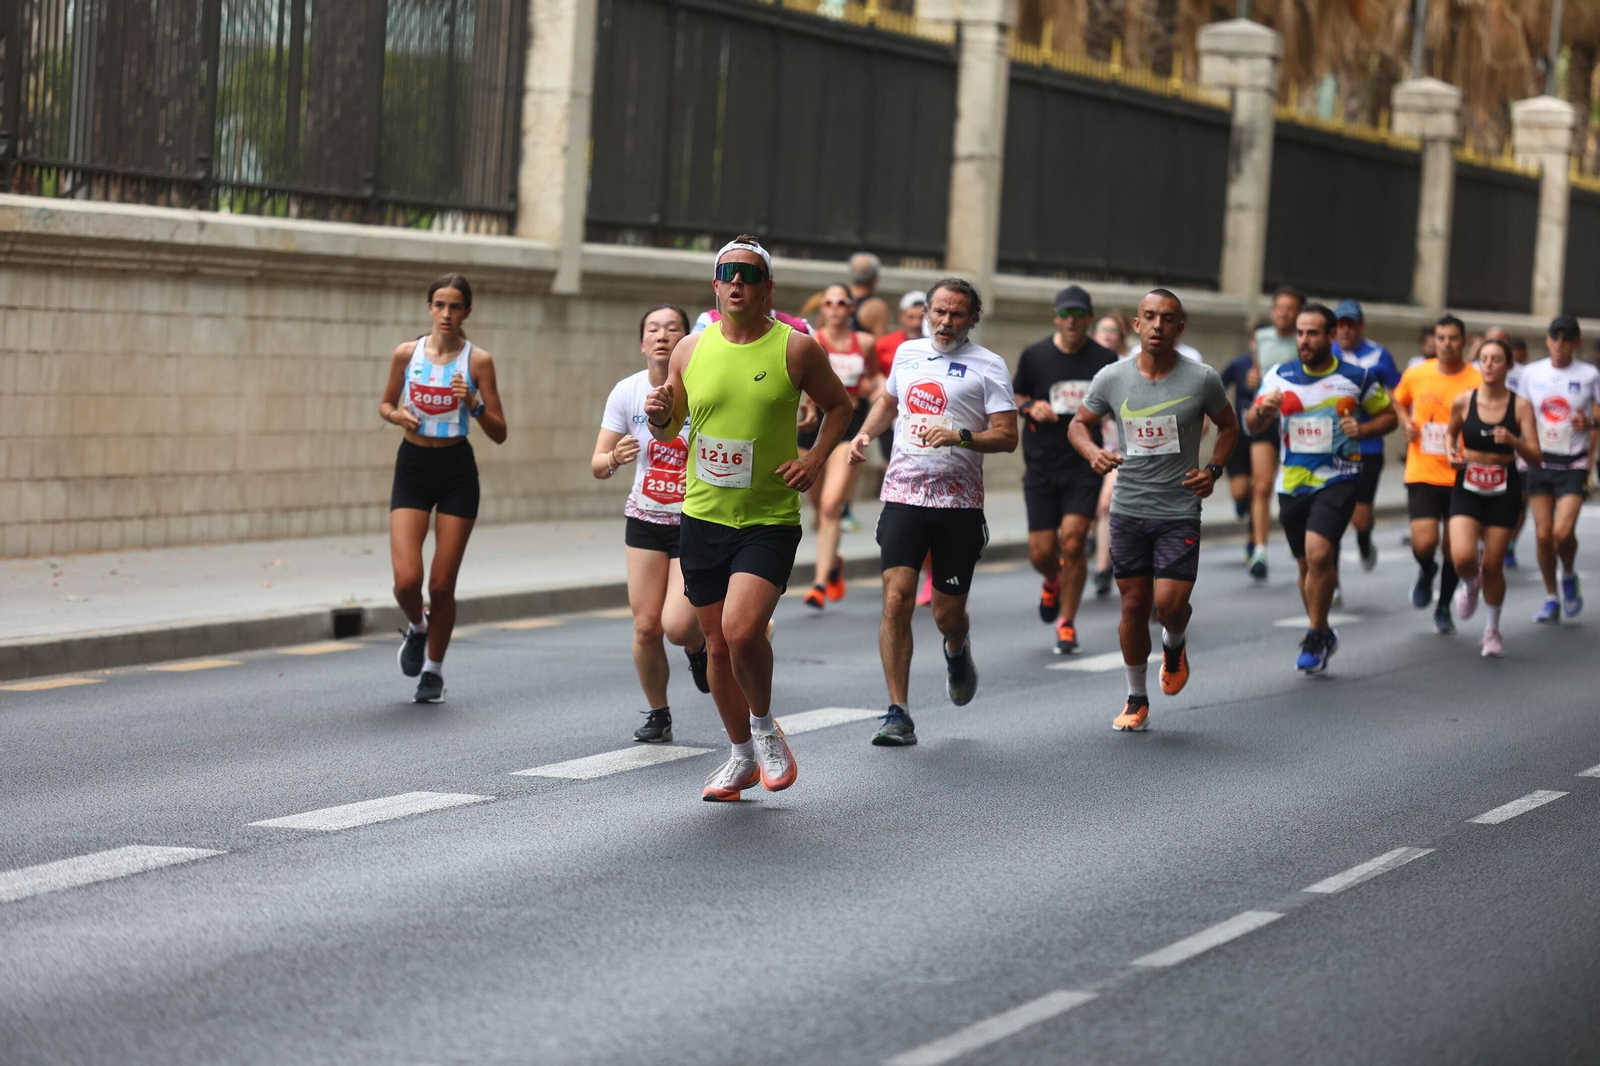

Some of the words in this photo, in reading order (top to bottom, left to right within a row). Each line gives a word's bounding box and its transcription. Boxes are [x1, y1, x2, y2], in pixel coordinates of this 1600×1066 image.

[947, 368, 962, 377] AXA
[414, 391, 453, 405] 2088
[911, 387, 942, 406] PONLE
[908, 396, 939, 414] FRENO
[1137, 426, 1164, 438] 151
[653, 444, 687, 459] PONLE
[701, 447, 743, 466] 1216
